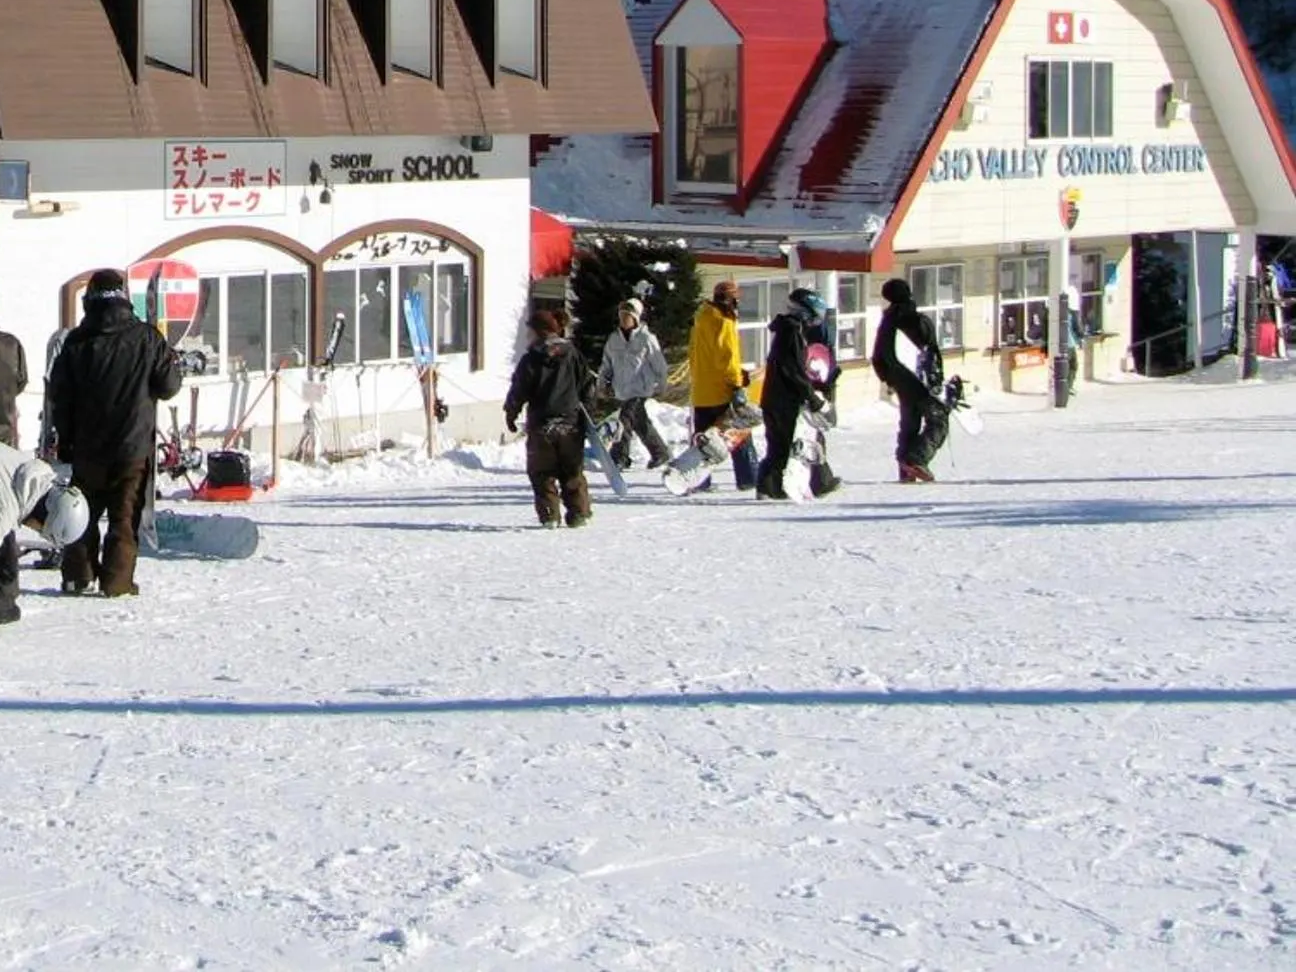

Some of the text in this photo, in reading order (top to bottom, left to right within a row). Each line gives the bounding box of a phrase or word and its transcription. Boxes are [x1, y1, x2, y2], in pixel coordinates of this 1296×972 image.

[172, 145, 227, 168] スキー
[330, 153, 372, 169] SNOW
[926, 144, 1206, 183] CHO VALLEY CONTROL CENTER
[172, 166, 282, 189] スノーボード
[348, 154, 480, 184] SPORT SCHOOL
[172, 191, 261, 214] テレマーク
